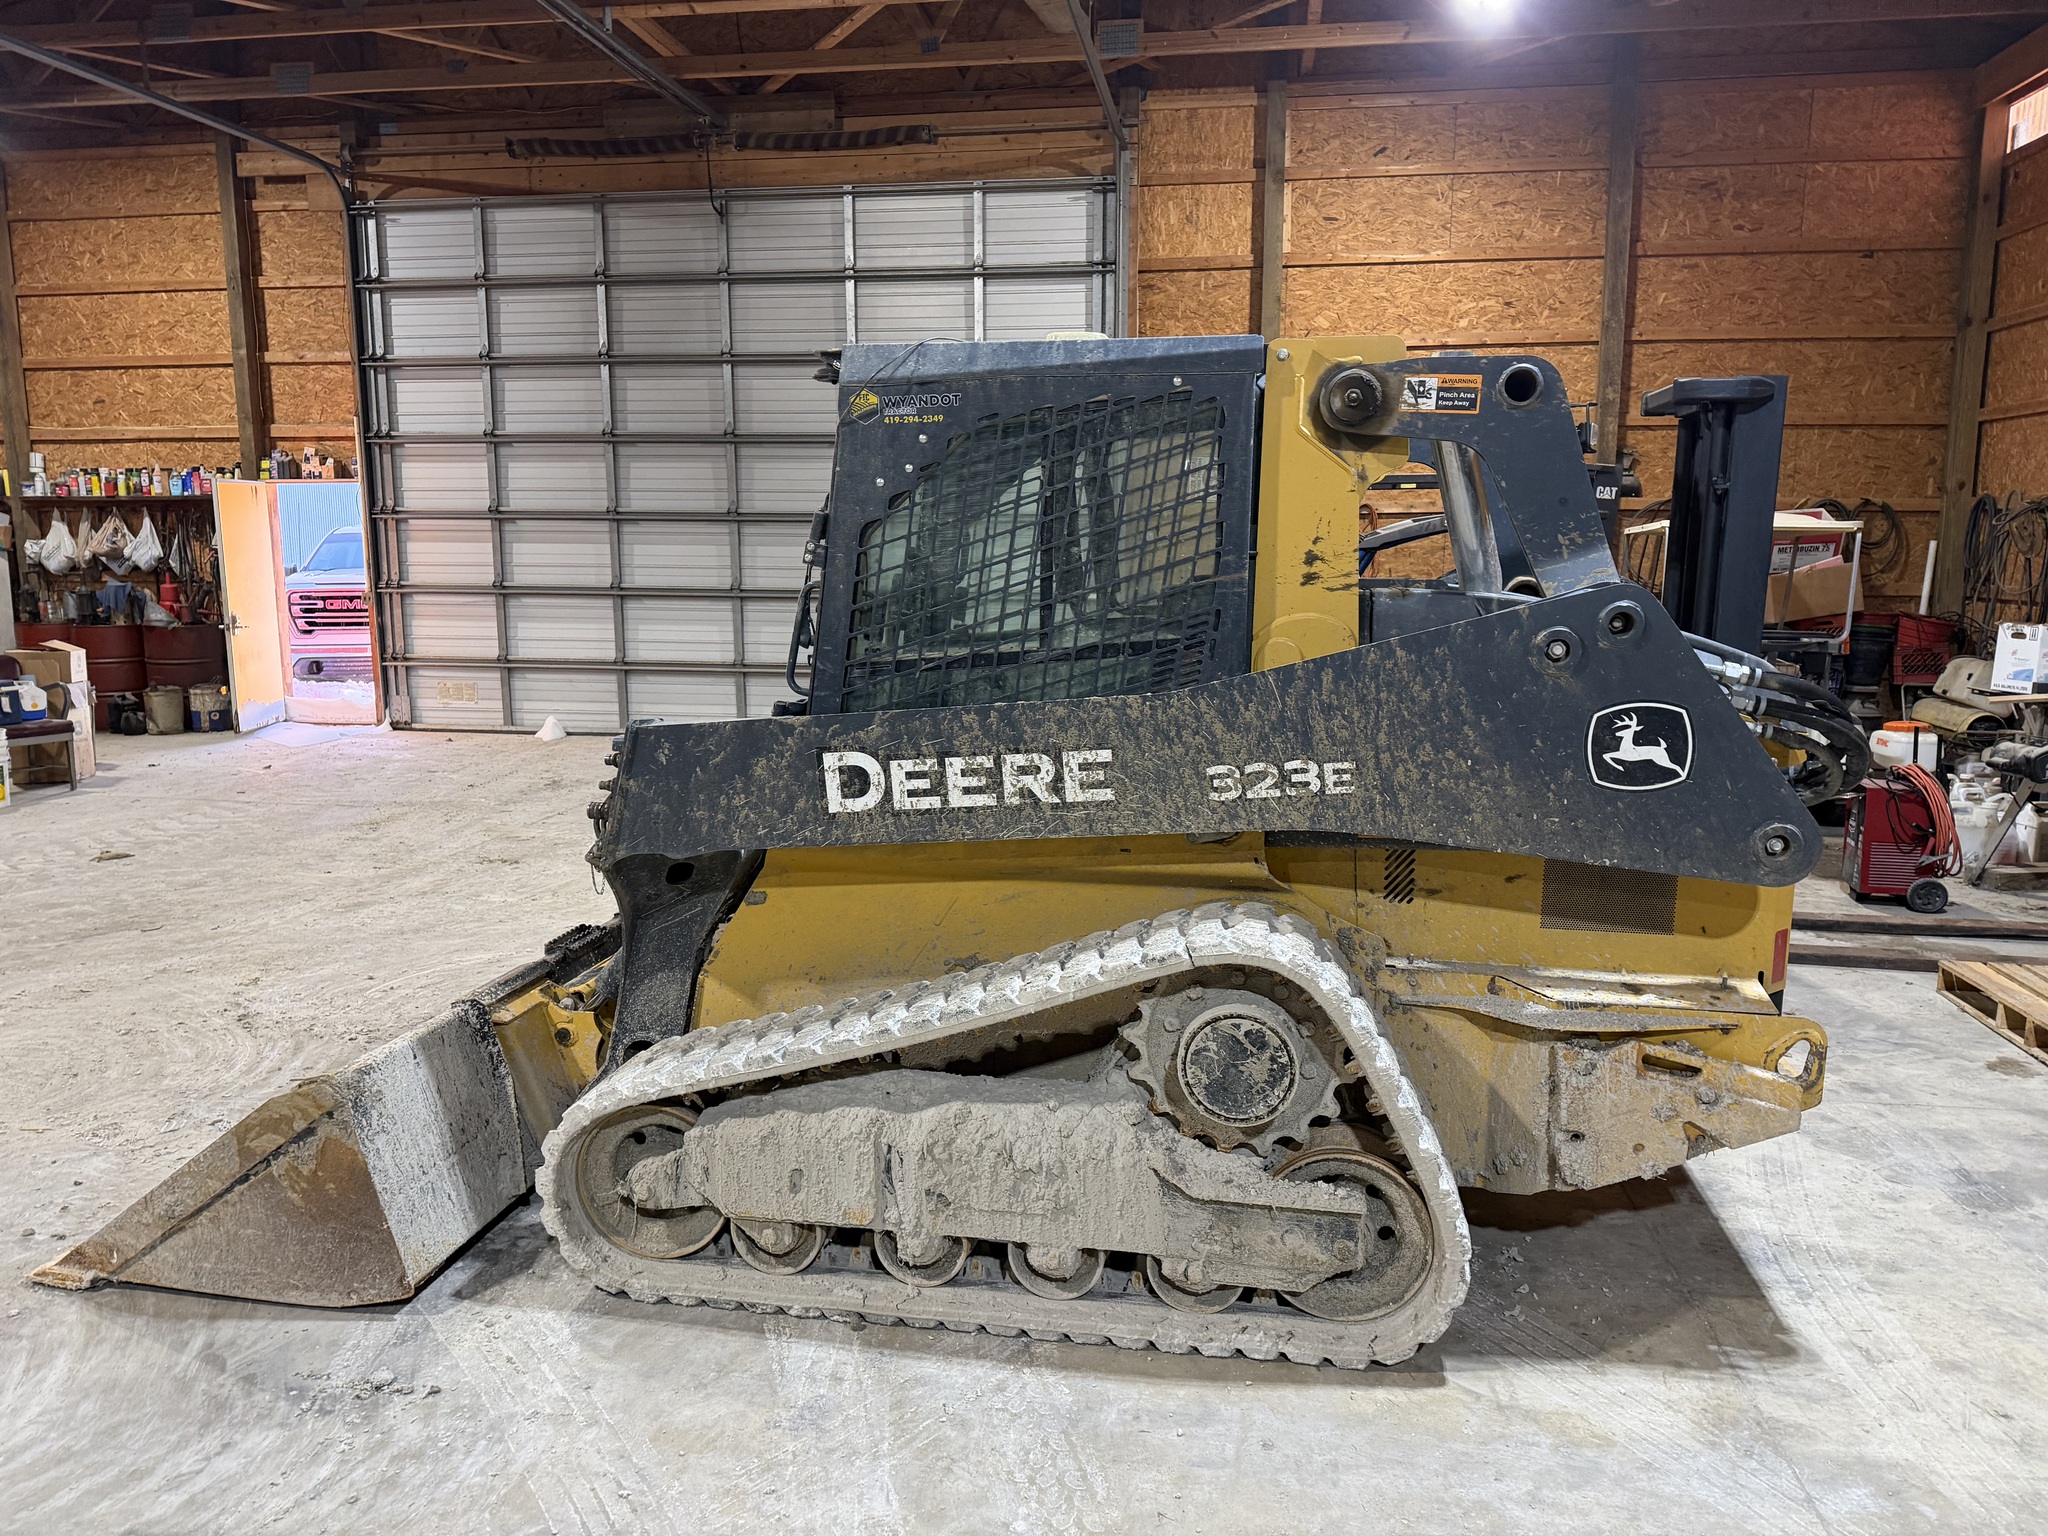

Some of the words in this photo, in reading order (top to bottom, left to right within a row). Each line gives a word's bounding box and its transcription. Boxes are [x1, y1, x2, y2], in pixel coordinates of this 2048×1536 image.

[882, 392, 961, 409] WYANDOT
[883, 415, 944, 424] 419-294-2349
[1596, 486, 1618, 500] CAT
[821, 748, 1116, 815] DEERE
[1205, 758, 1357, 803] 323E
